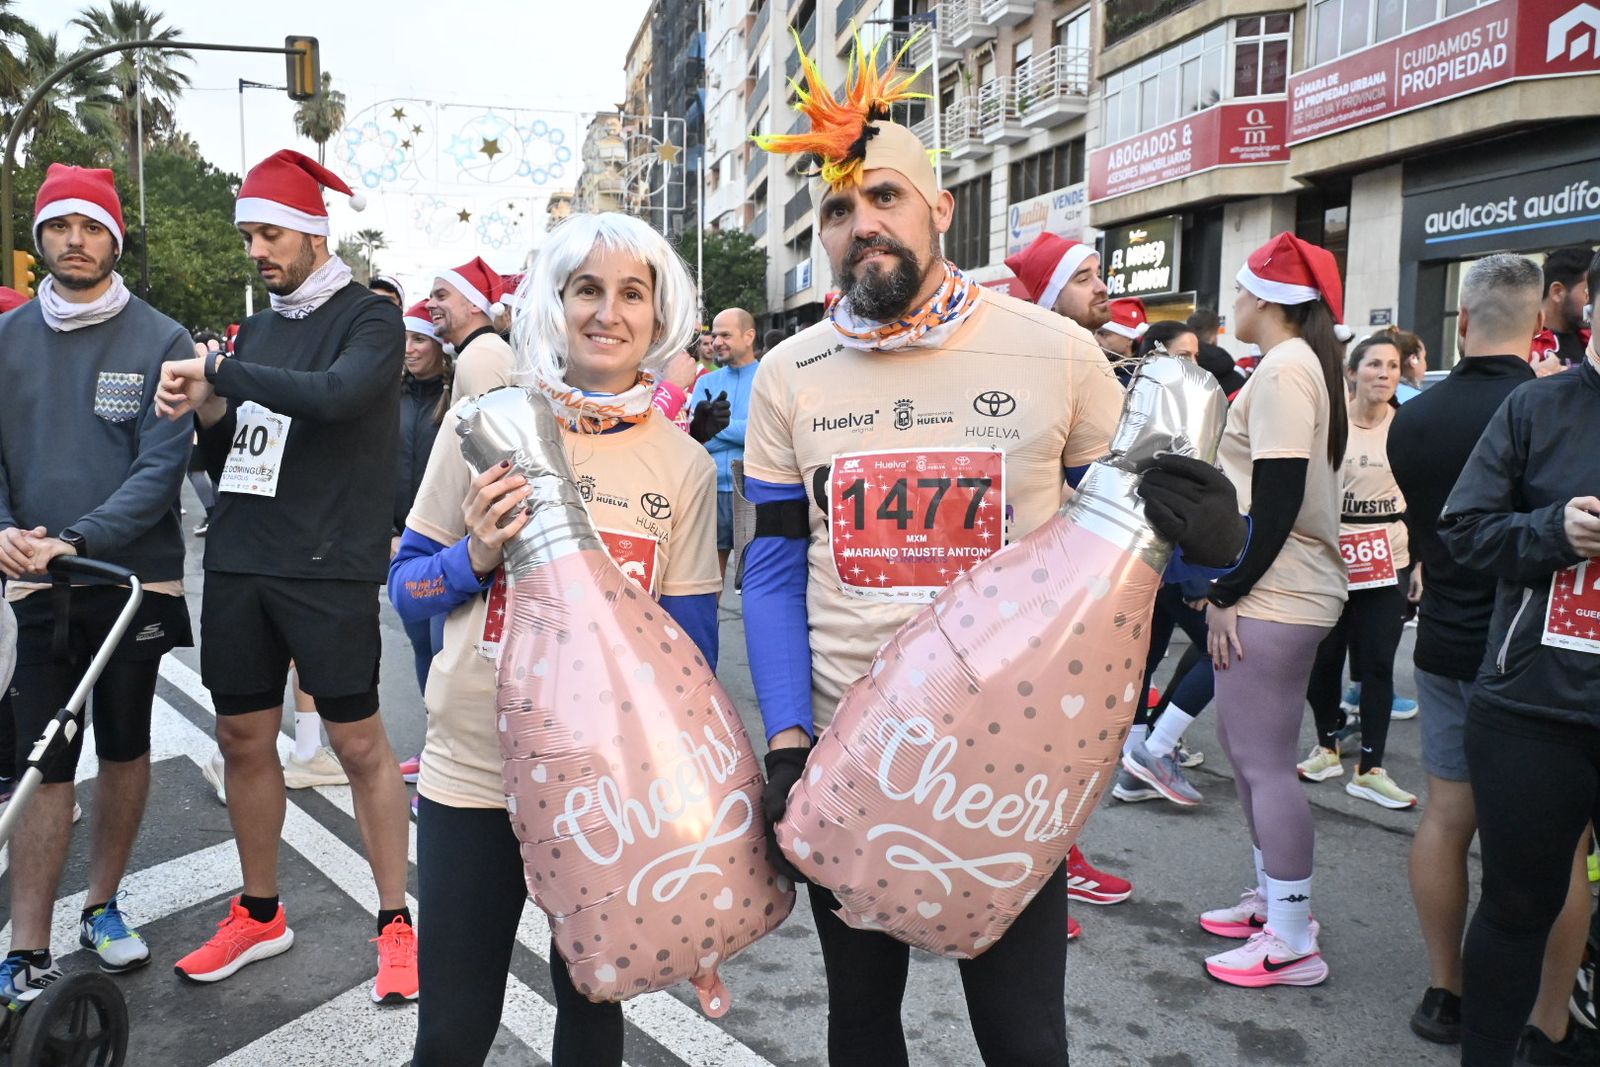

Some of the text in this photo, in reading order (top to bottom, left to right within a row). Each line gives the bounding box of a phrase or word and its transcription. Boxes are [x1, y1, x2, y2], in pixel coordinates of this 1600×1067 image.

[1402, 18, 1509, 71] CUIDAMOS TU
[1401, 44, 1508, 96] PROPIEDAD
[1293, 70, 1386, 112] LA PROPIEDAD URBANA
[1294, 72, 1339, 98] CÁMARA DE
[1293, 86, 1386, 125] DE HUELVA Y PROVINCIA
[1107, 123, 1193, 171] ABOGADOS &
[1107, 147, 1192, 185] ASESORES INMOBILIARIOS
[1053, 188, 1084, 210] VENDE
[1011, 202, 1050, 233] Quality
[1425, 196, 1518, 234] audicost
[1112, 240, 1166, 269] EL MUSEO
[1106, 273, 1126, 295] DEL
[795, 348, 832, 369] luanvi
[812, 412, 874, 433] Huelva
[917, 416, 954, 425] HUELVA
[965, 426, 1021, 440] HUELVA
[233, 424, 268, 457] 40
[875, 460, 906, 469] Huelva
[596, 496, 629, 509] HUELVA
[842, 477, 992, 531] 1477
[1342, 499, 1397, 514] ILVESTRE
[1344, 491, 1354, 500] AN
[635, 515, 669, 543] HUELVA
[906, 534, 928, 543] MXM
[846, 547, 899, 558] MARIANO
[902, 547, 945, 558] TAUSTE
[553, 695, 742, 865] Cheers!
[878, 716, 1100, 842] Cheers!
